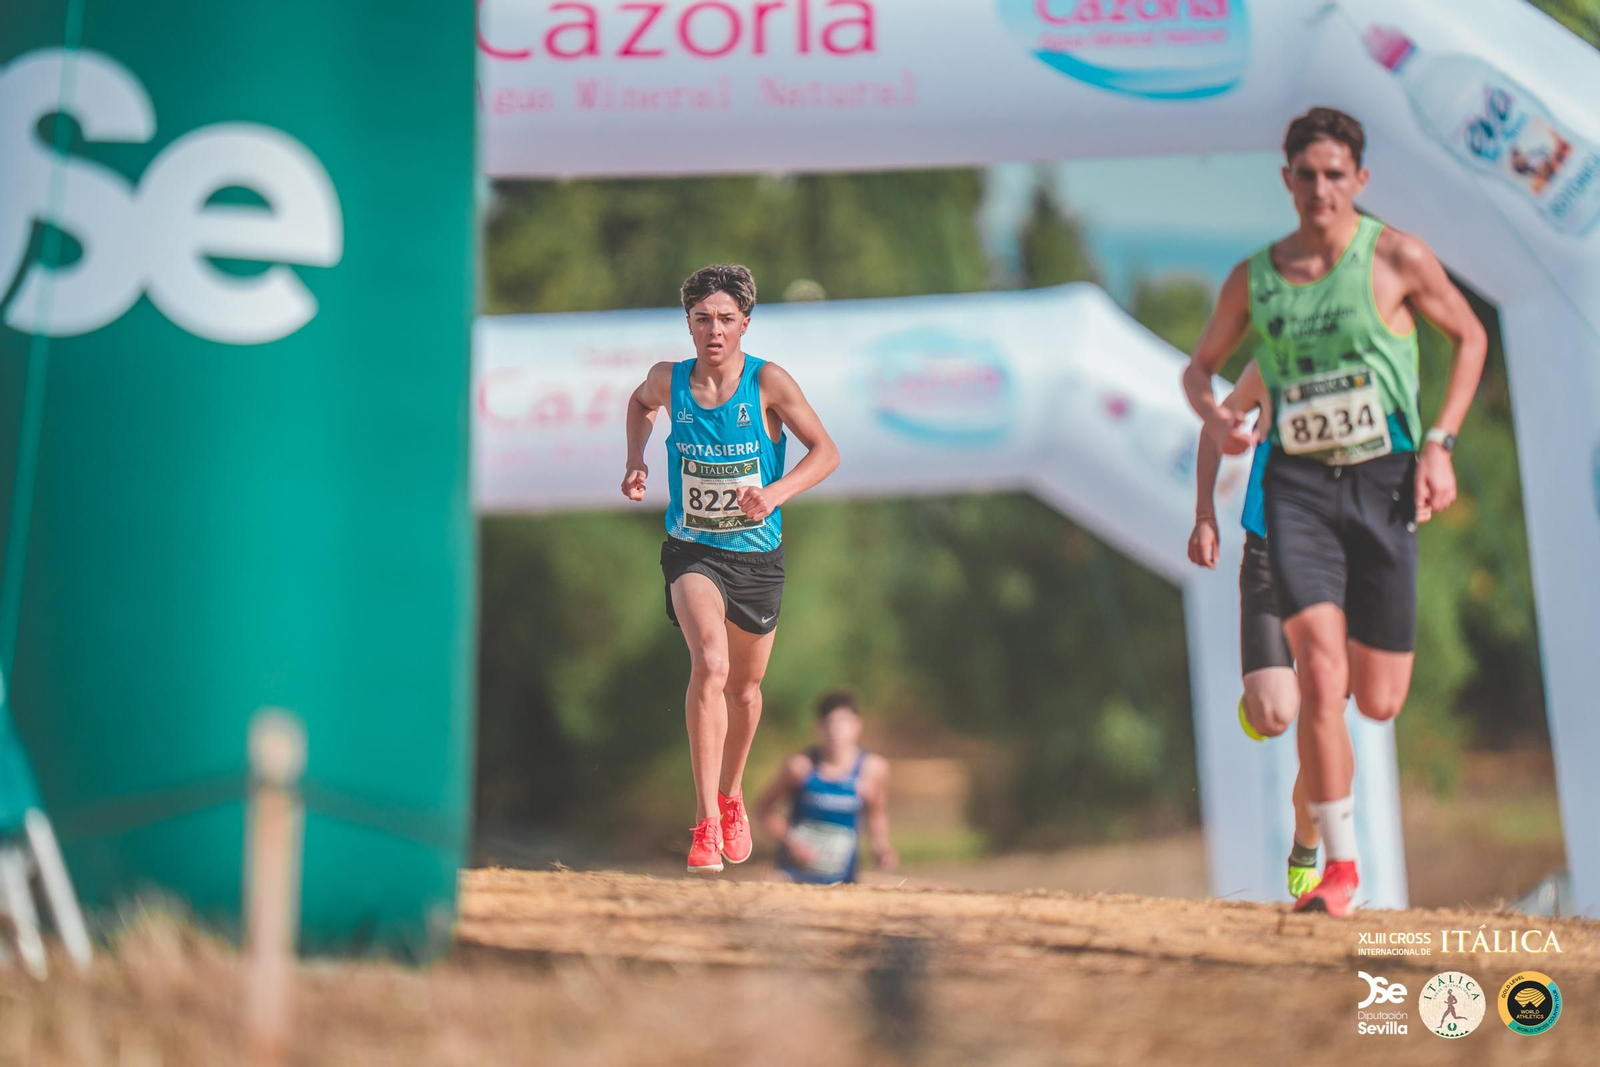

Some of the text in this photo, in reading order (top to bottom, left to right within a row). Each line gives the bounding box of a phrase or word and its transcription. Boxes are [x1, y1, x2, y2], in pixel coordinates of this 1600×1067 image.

[476, 0, 878, 60] Cazorla
[476, 70, 917, 116] gua Mineral Natural
[1291, 404, 1375, 444] 8234
[689, 487, 740, 512] 822
